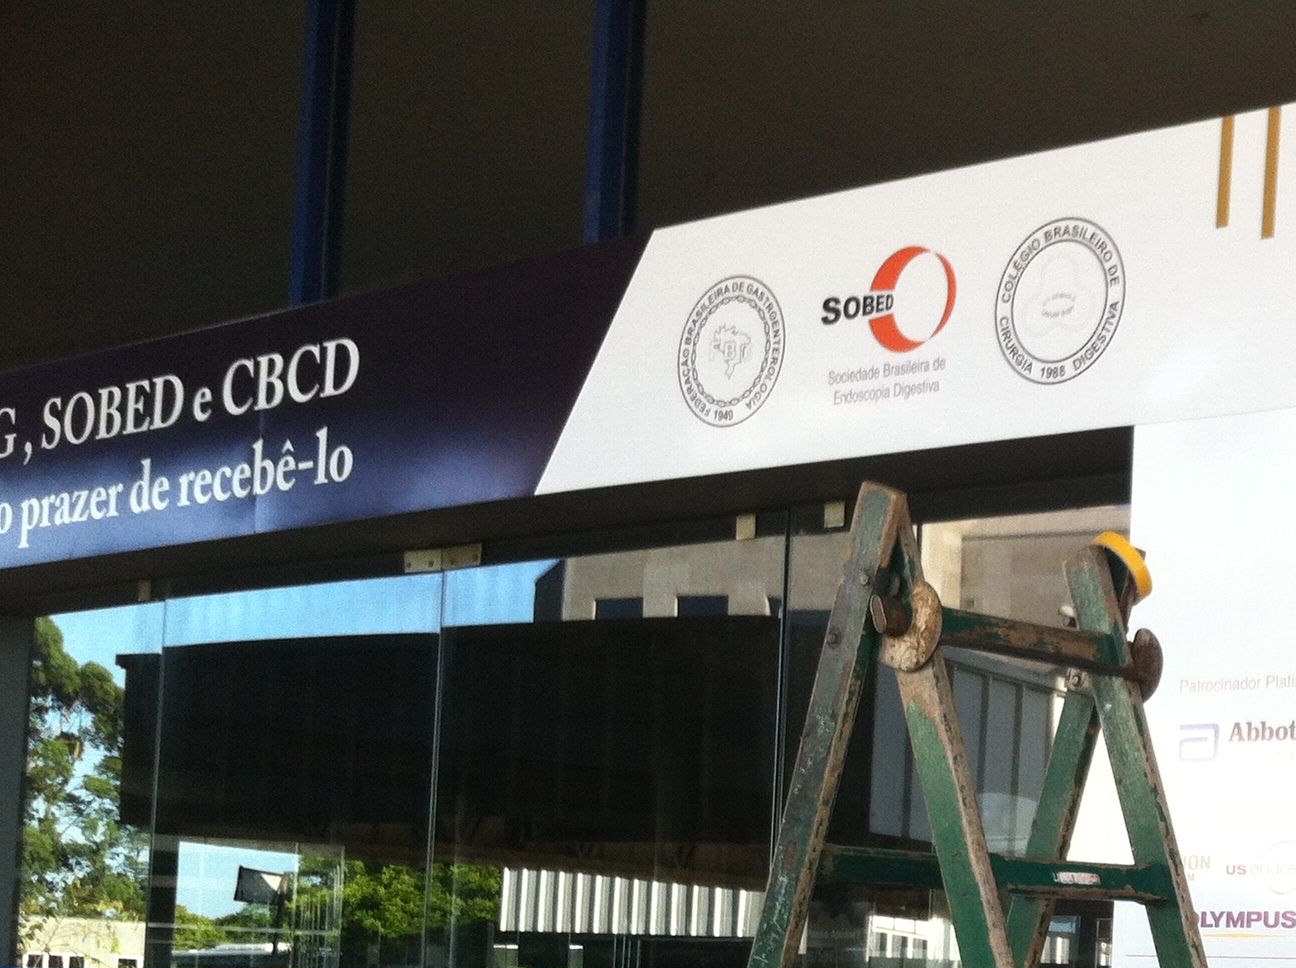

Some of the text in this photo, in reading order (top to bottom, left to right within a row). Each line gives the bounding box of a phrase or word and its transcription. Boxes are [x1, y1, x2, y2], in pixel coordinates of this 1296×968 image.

[1044, 224, 1113, 262] BRASILEIRO
[1107, 264, 1120, 288] DE
[821, 293, 895, 326] SOBED
[684, 283, 730, 346] BRASILEIRA
[731, 281, 745, 293] DE
[746, 284, 781, 410] GASTROENTEROLOGIA
[999, 316, 1034, 375] CIRURGIA
[1040, 365, 1067, 380] 1988
[1072, 300, 1120, 371] DIGESTIVA
[828, 356, 947, 386] Sociedade Brasileira de
[41, 374, 185, 450] SOBED
[192, 387, 213, 422] e
[222, 338, 360, 416] CBCD
[833, 379, 941, 405] Endoscopia Digestiva
[713, 410, 734, 422] 1949
[18, 483, 124, 548] prazer
[130, 458, 170, 514] de
[177, 426, 354, 507] recebê-lo
[1179, 676, 1262, 694] Patrocinador
[1226, 864, 1247, 876] US
